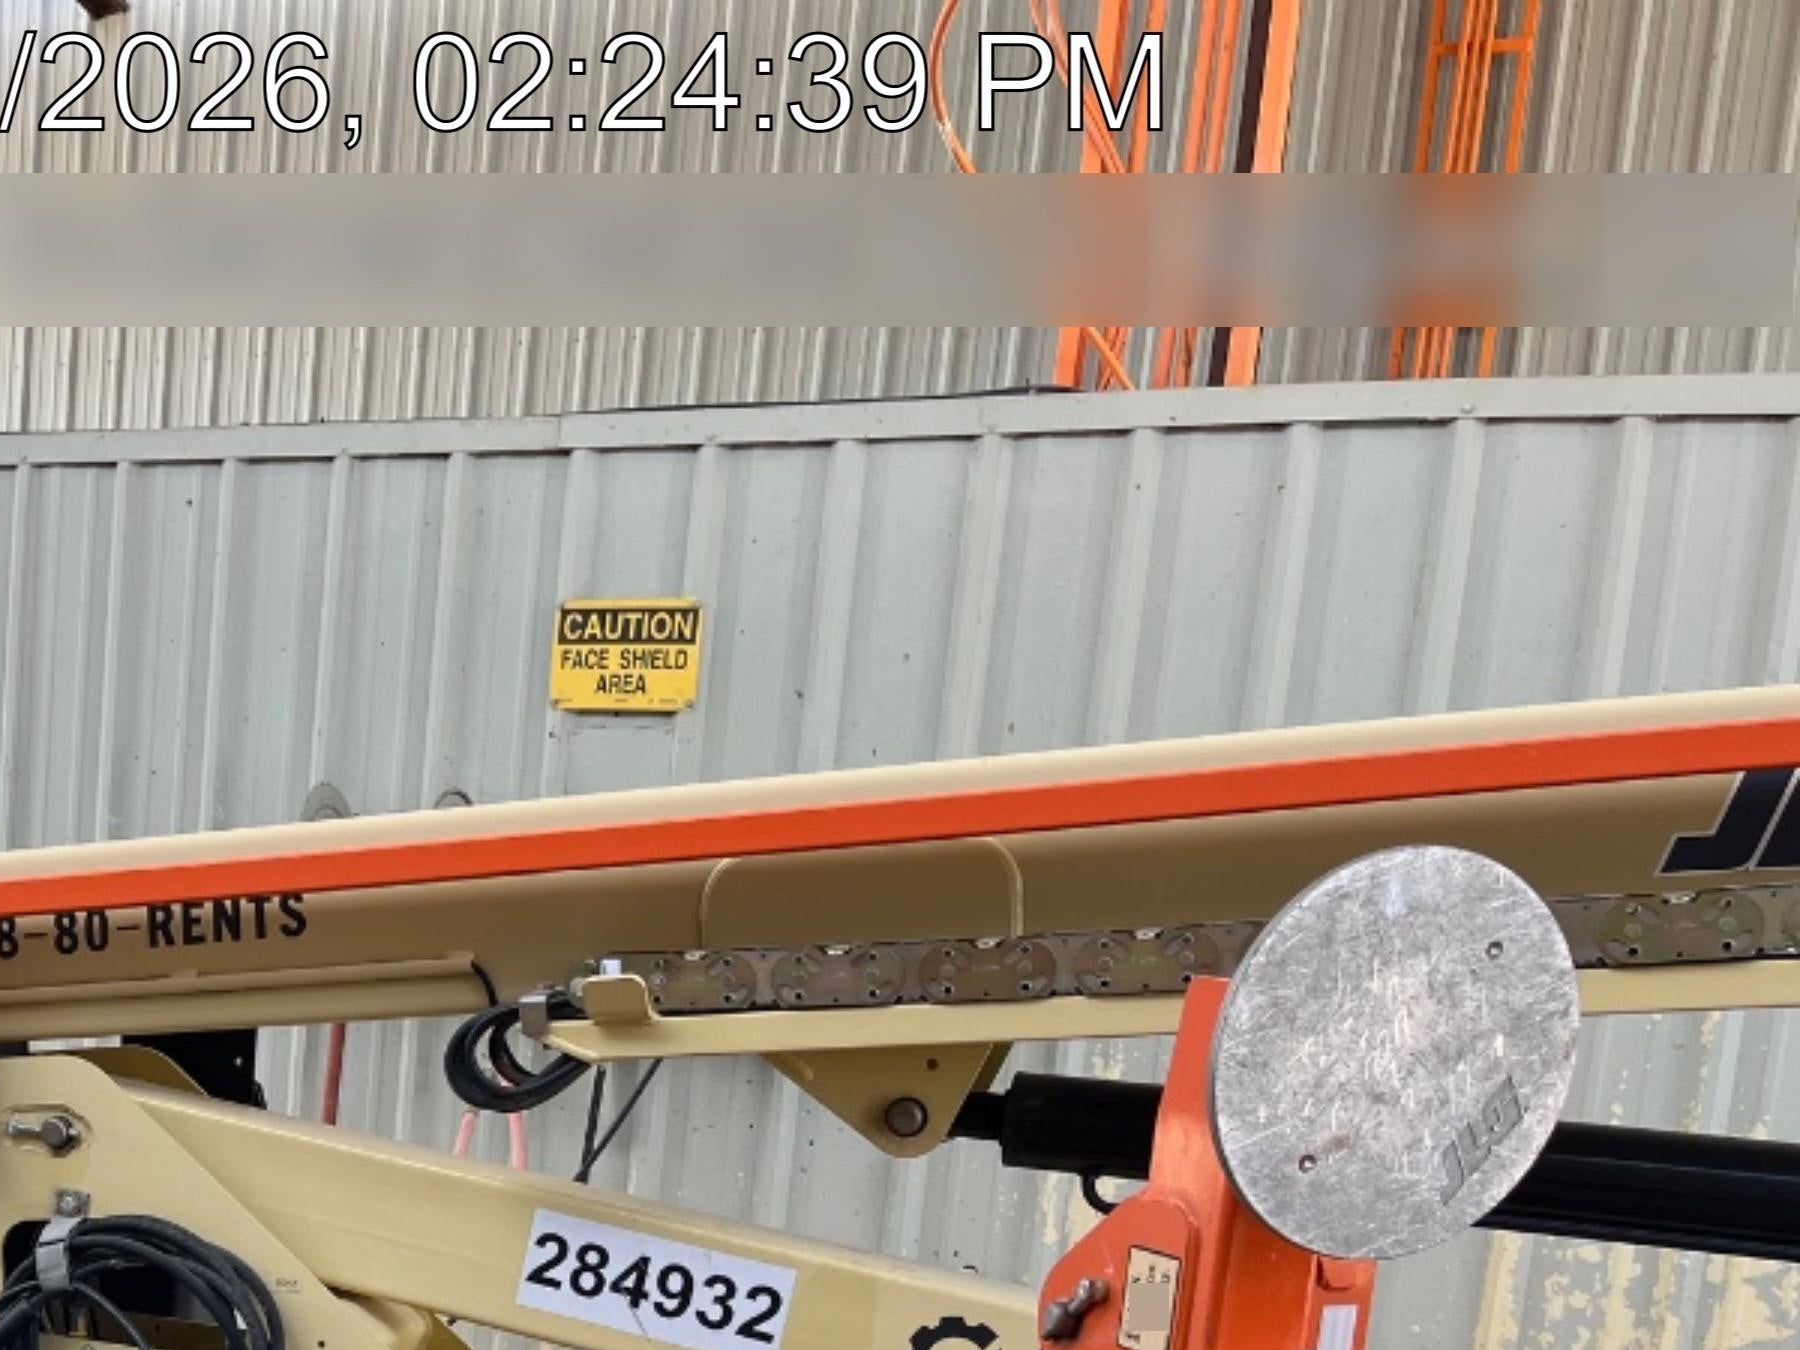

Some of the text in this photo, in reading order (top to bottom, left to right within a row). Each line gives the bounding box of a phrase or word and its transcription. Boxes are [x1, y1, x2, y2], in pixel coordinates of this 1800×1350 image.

[563, 611, 694, 640] CAUTION
[561, 648, 688, 670] FACE SHIELD
[595, 674, 646, 694] AREA
[1439, 1072, 1530, 1207] JLG
[524, 1231, 783, 1345] 284932
